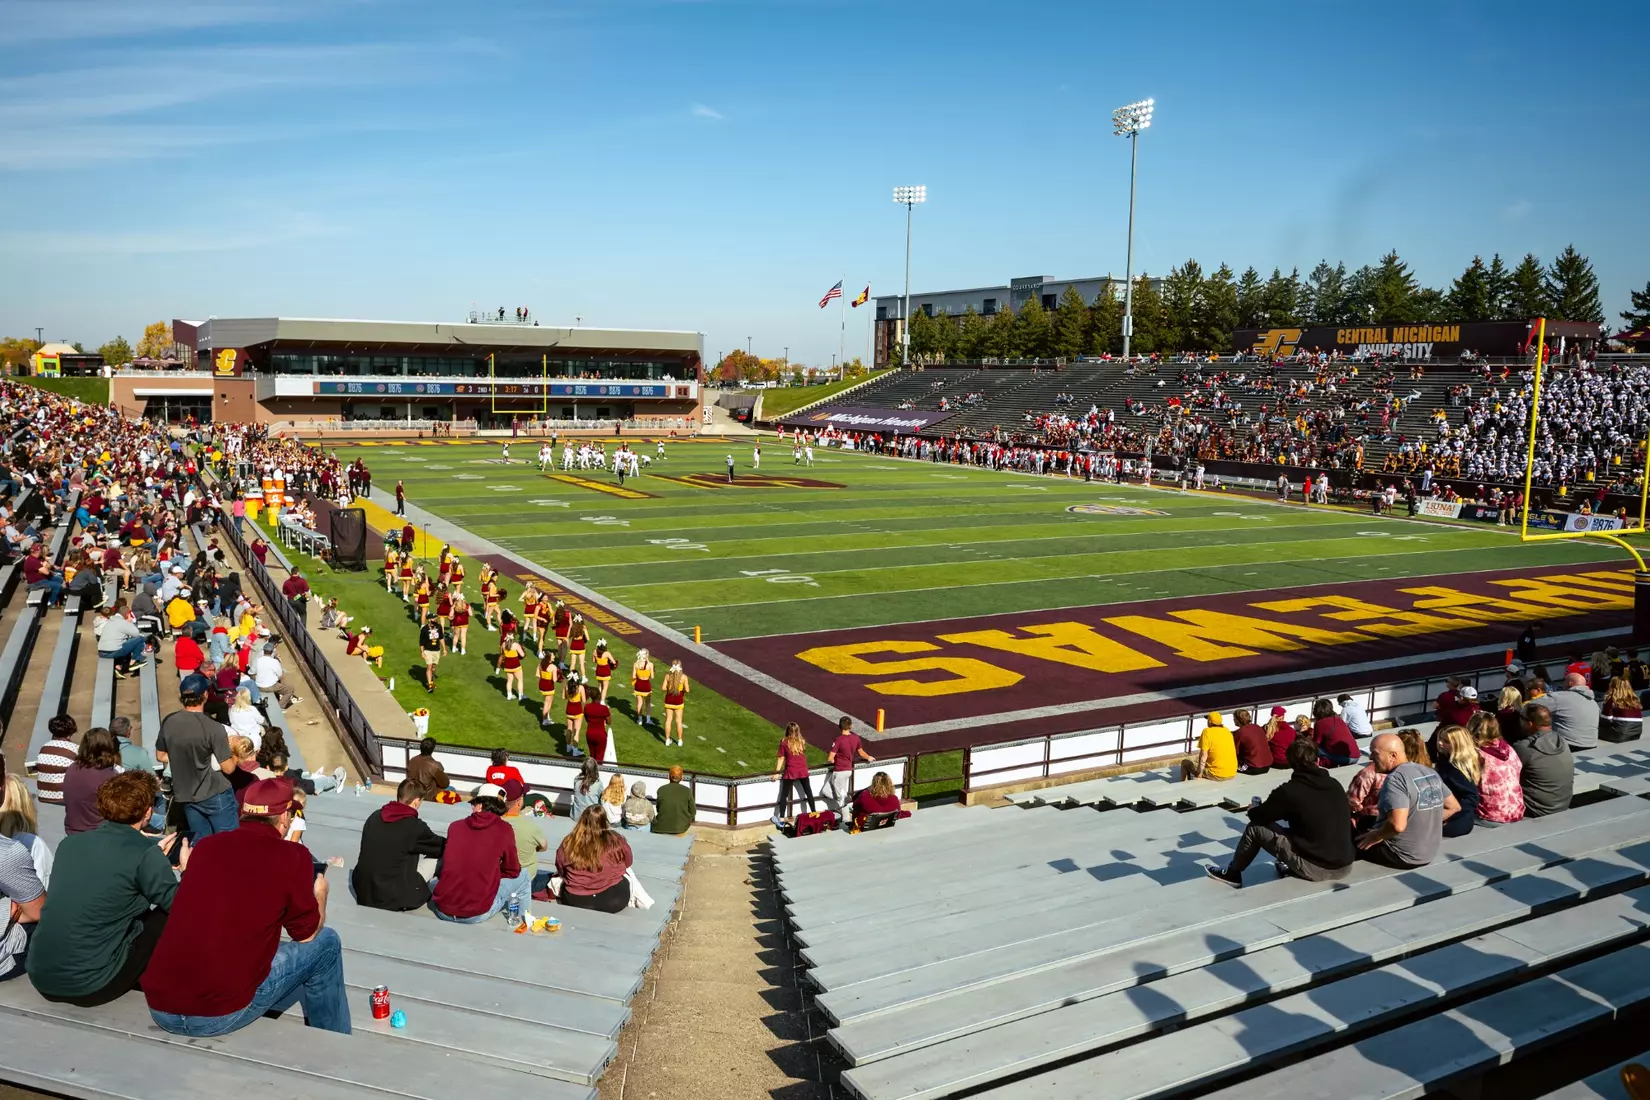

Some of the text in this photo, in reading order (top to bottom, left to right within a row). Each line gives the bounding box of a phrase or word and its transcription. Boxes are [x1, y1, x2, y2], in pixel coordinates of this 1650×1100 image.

[1337, 325, 1460, 344] CENTRAL MICHIGAN
[505, 385, 517, 393] 3:17
[1517, 511, 1546, 520] EGLE
